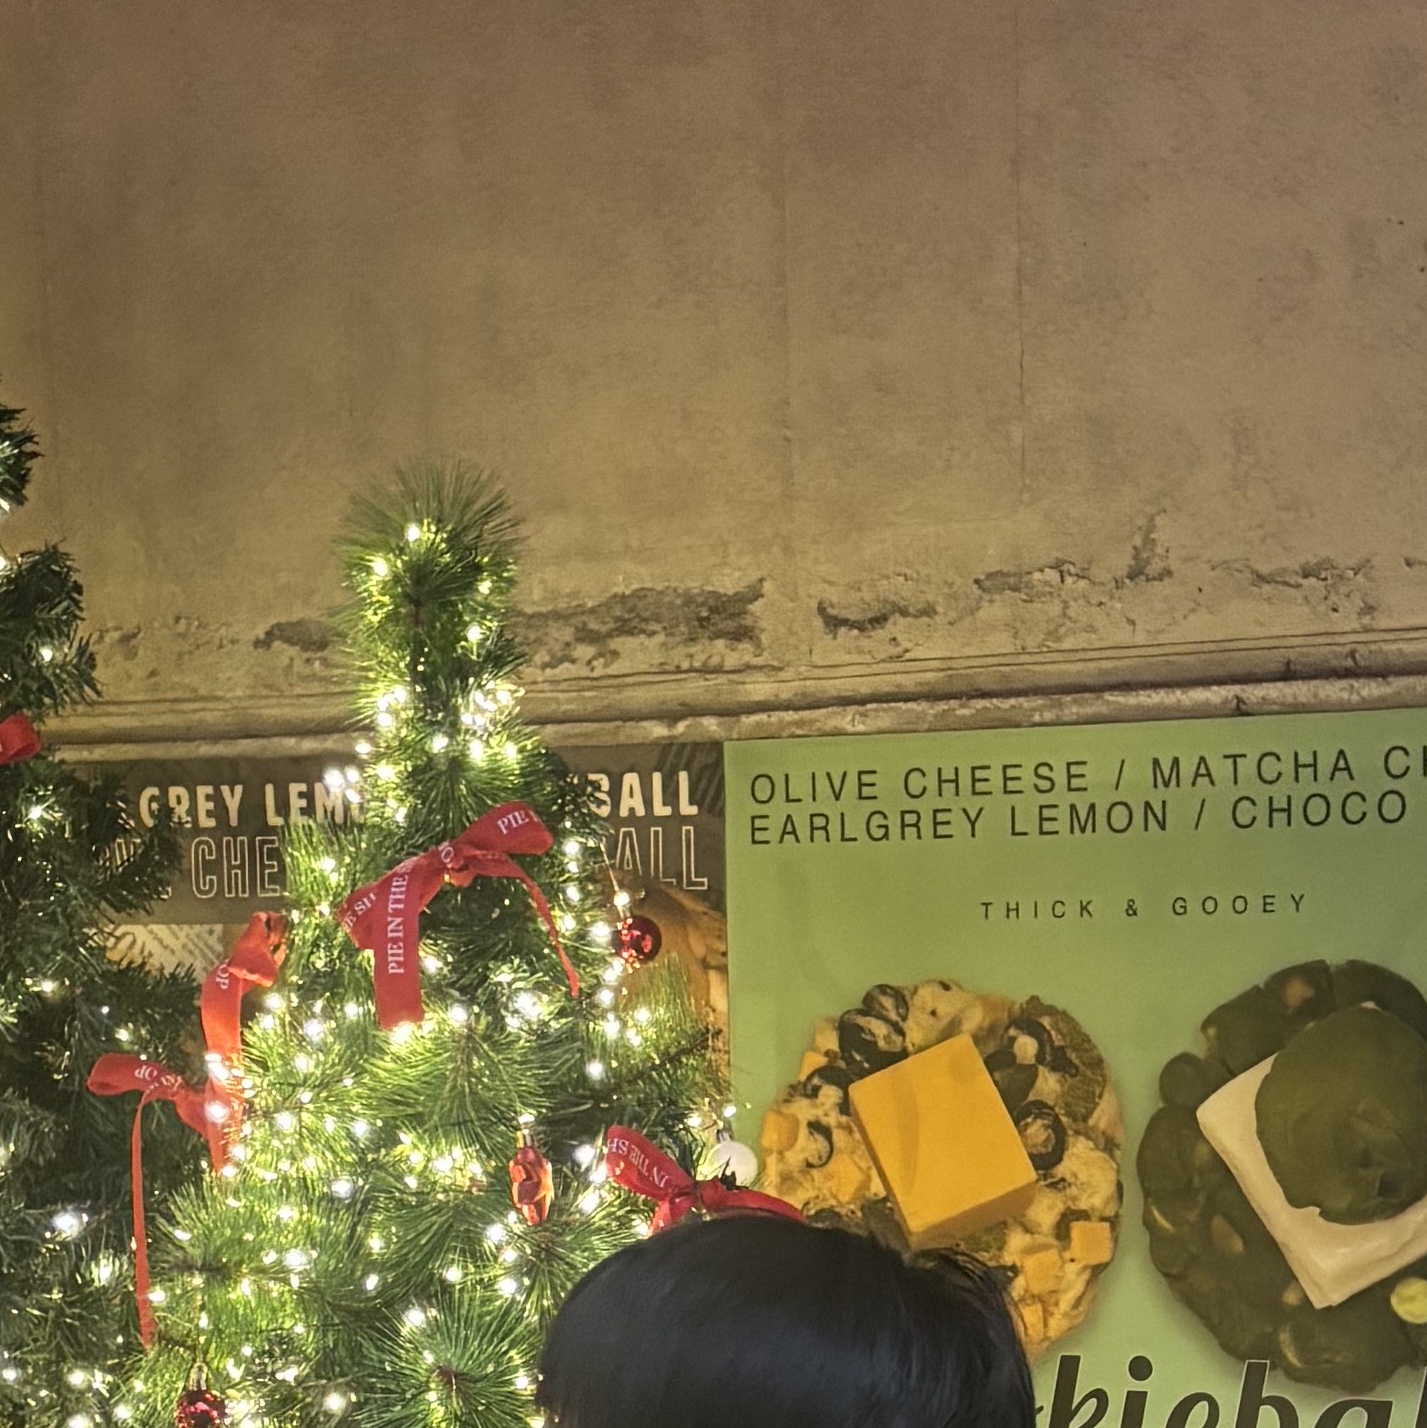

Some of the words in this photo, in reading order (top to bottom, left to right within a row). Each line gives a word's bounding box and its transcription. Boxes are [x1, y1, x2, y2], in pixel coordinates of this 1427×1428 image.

[749, 767, 880, 804] OLIVE
[903, 761, 1090, 799] CHEESE
[1151, 748, 1355, 790] MATCHA
[497, 810, 529, 835] PIE
[749, 806, 984, 846] EARLGREY
[1009, 798, 1168, 836] LEMON
[1232, 789, 1407, 829] CHOCO
[390, 875, 407, 915] THE
[980, 898, 1096, 921] THICK
[1173, 893, 1309, 916] GOOEY
[390, 915, 405, 941] IN
[388, 942, 405, 974] PIE
